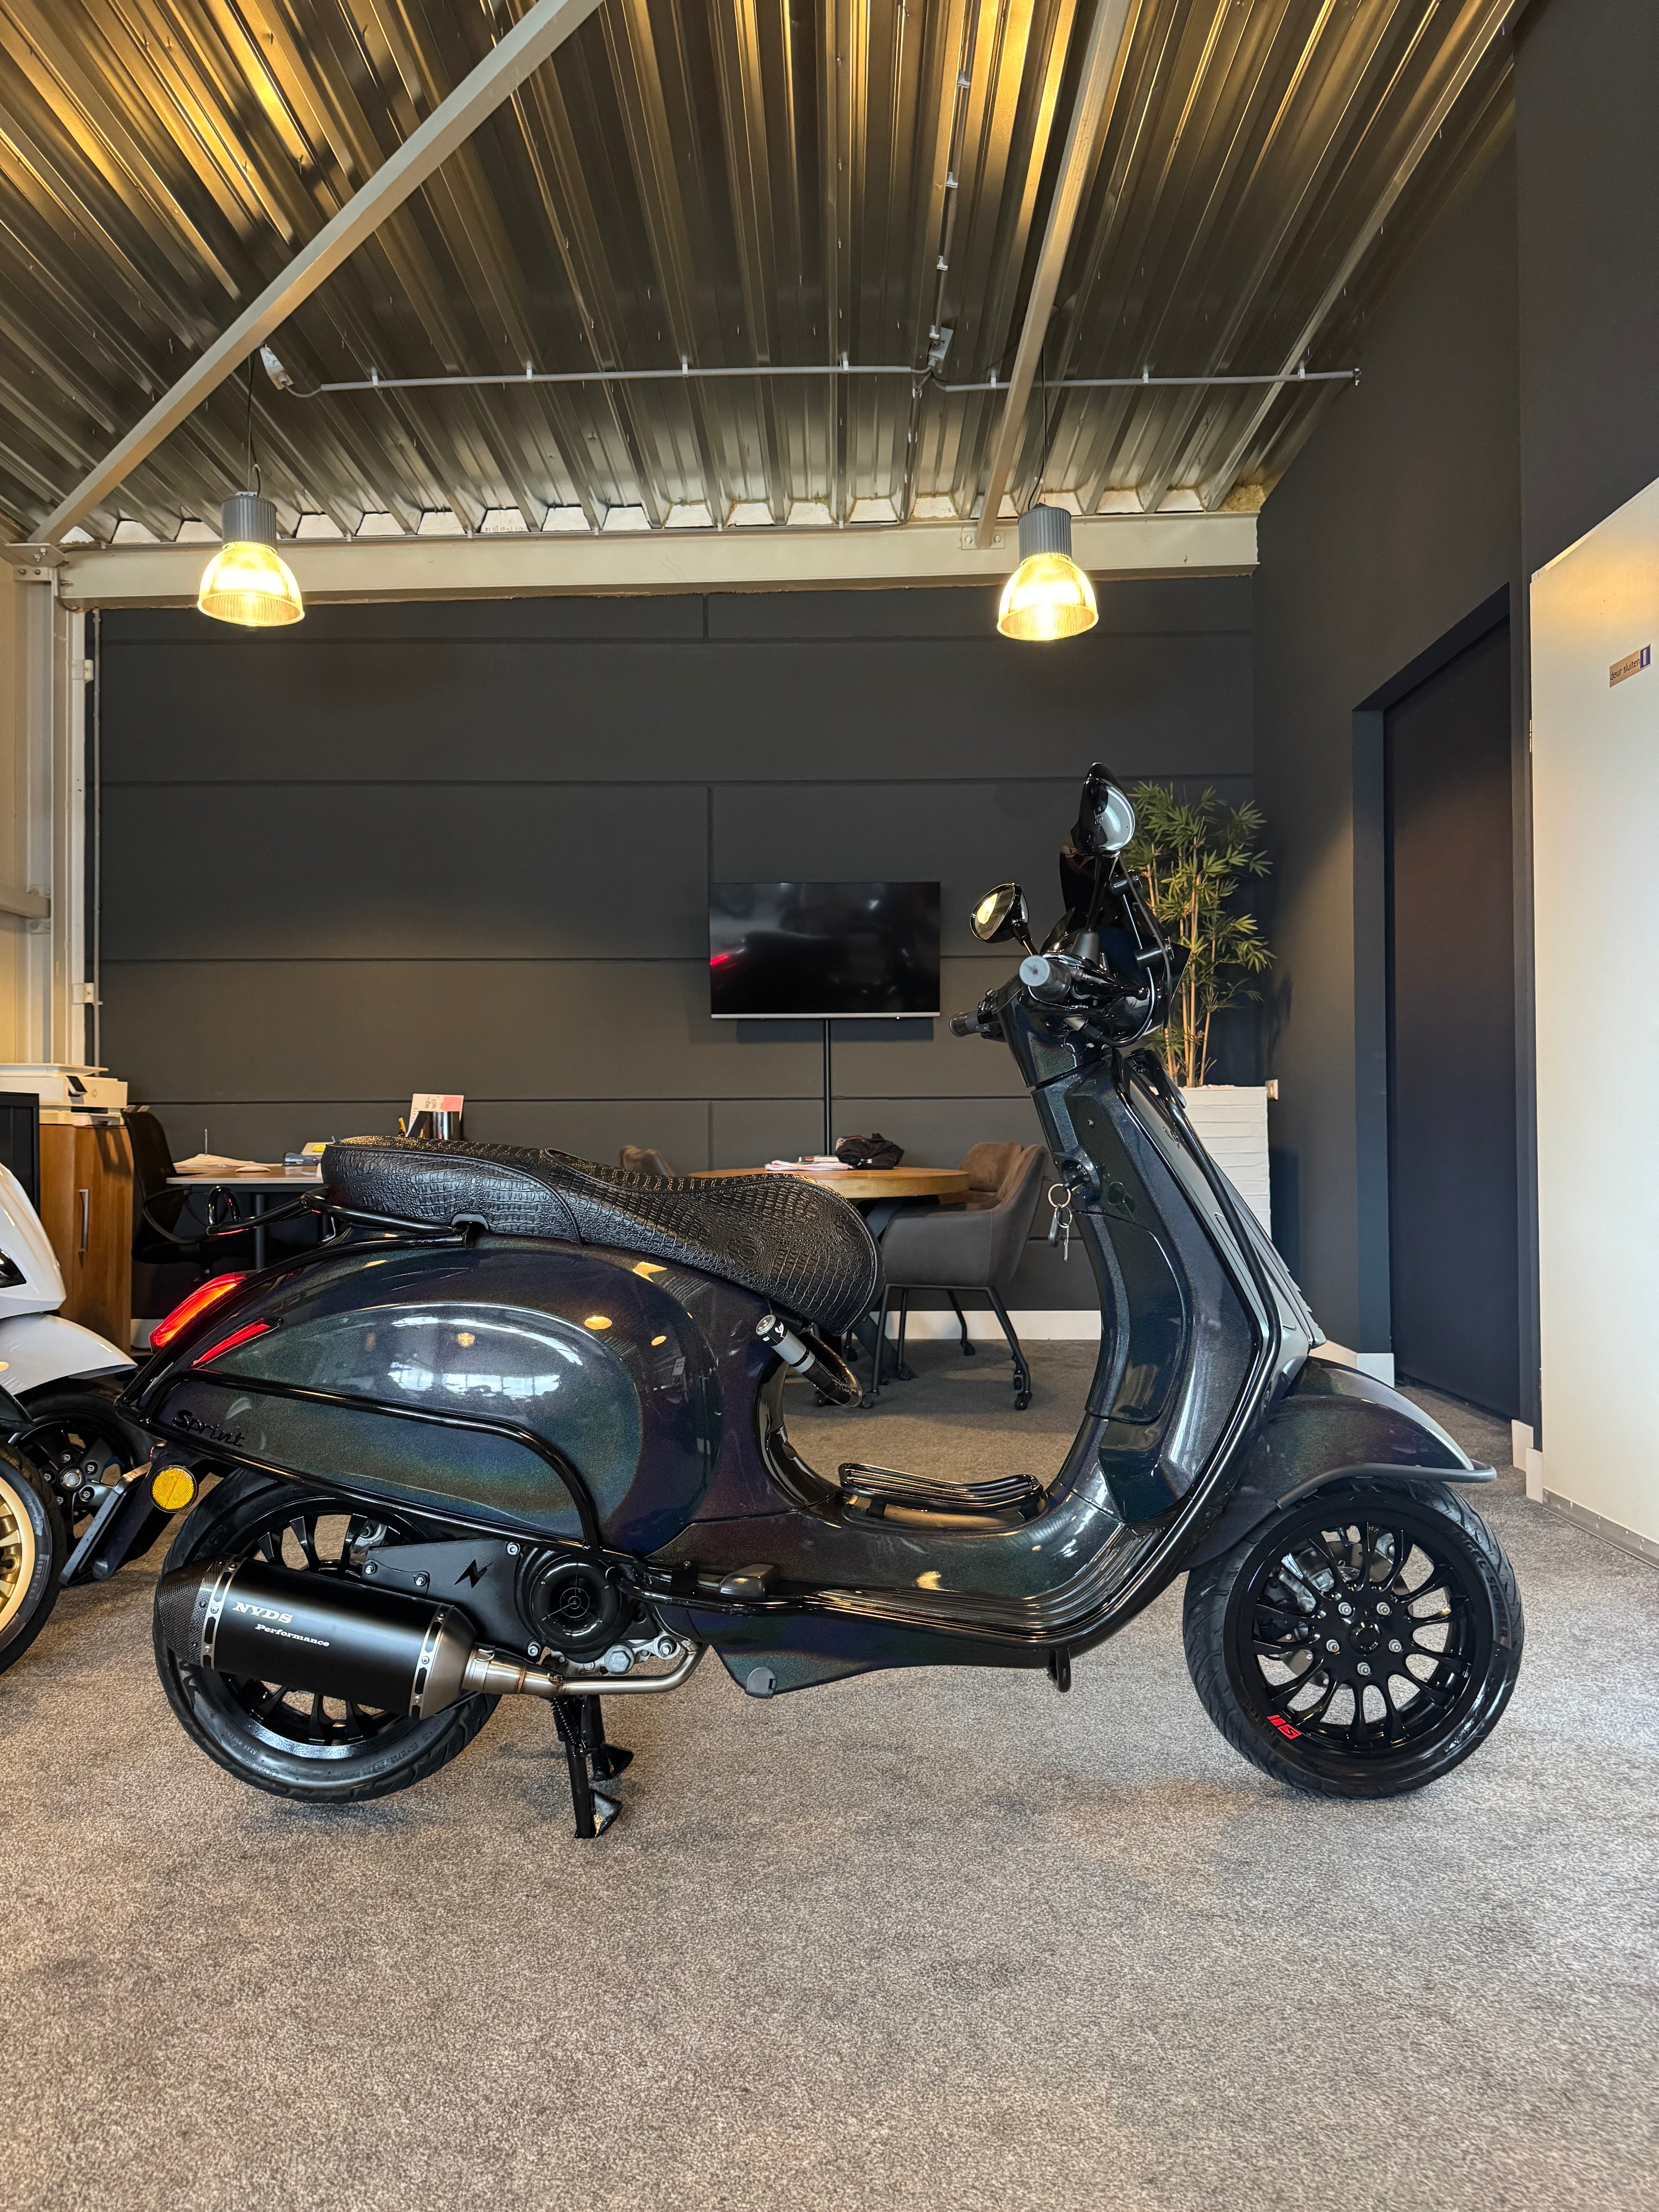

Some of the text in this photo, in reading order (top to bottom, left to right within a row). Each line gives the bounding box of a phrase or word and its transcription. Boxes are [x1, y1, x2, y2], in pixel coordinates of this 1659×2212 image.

[1610, 659, 1640, 680] deur sluiten
[172, 1409, 246, 1447] Sprint
[232, 1602, 294, 1623] NYDS
[254, 1624, 330, 1647] Performance
